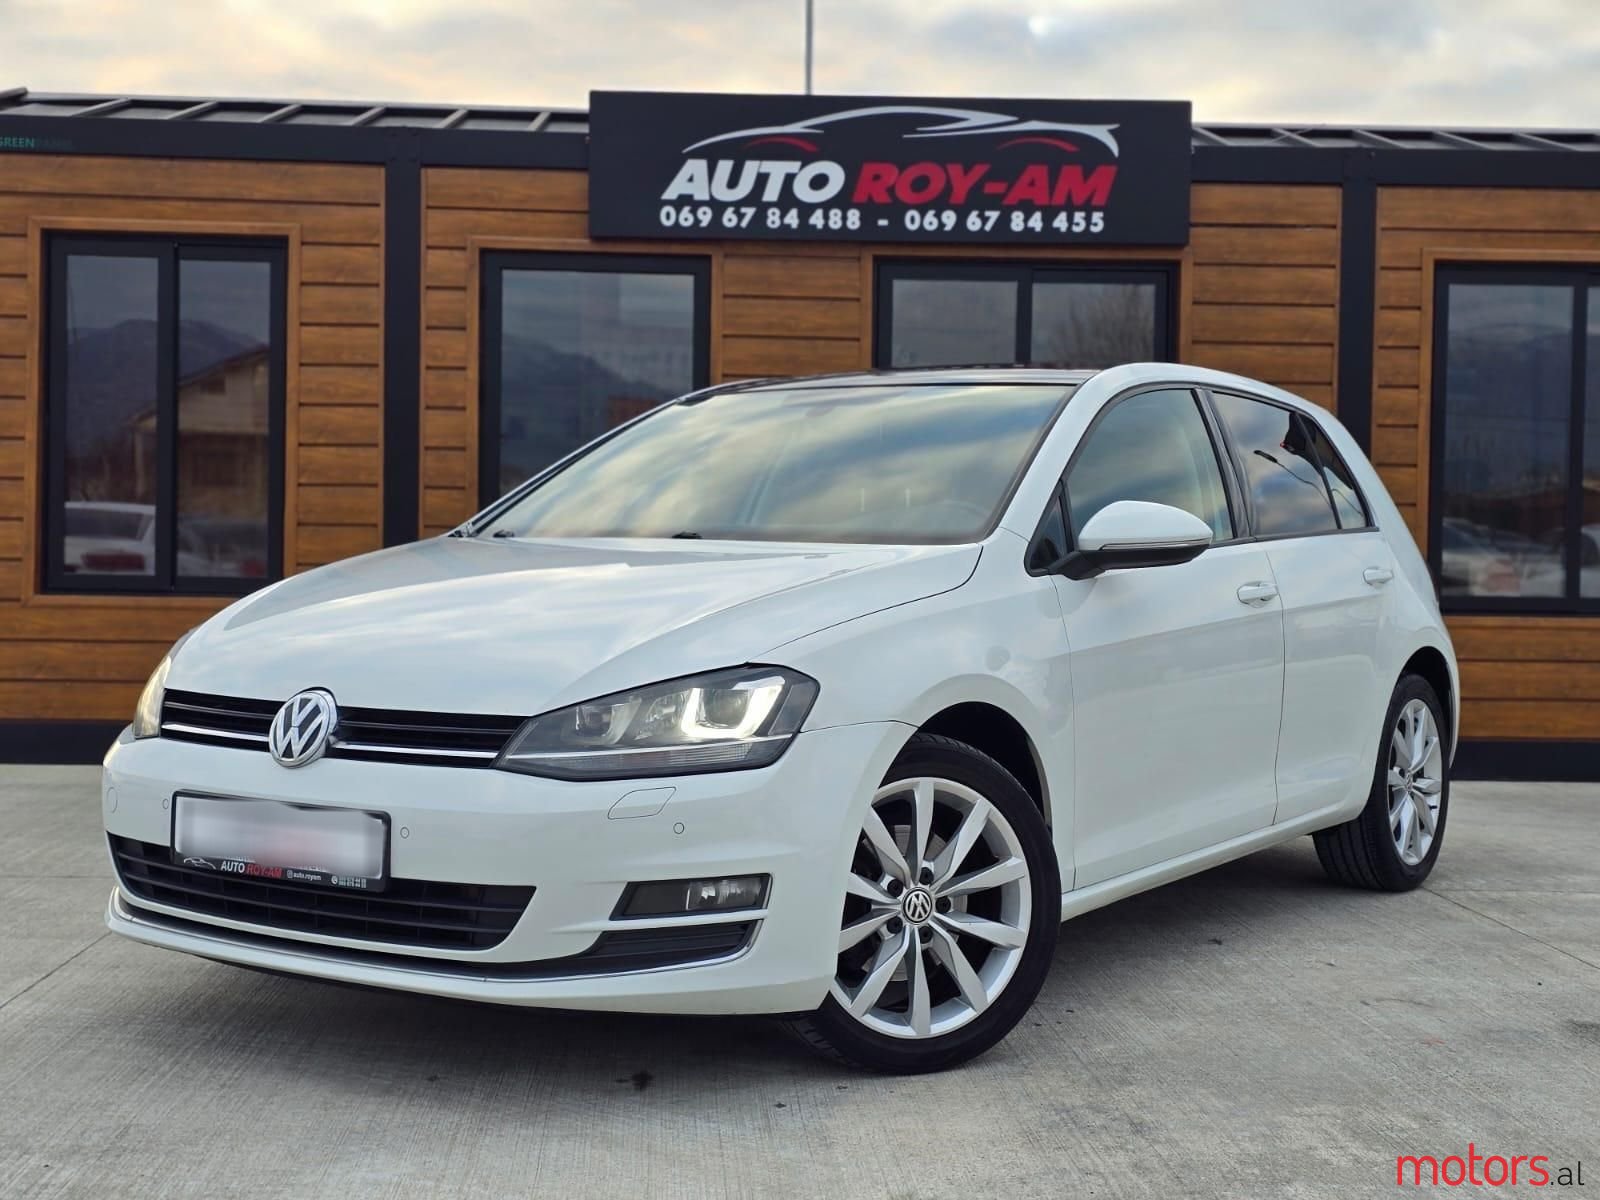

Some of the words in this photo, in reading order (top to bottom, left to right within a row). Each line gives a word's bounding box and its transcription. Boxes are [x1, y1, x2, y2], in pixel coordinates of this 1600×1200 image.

[660, 158, 846, 204] AUTO
[852, 161, 1118, 207] ROY-AM
[659, 205, 713, 228] 069
[721, 206, 757, 229] 67
[765, 206, 800, 230] 84
[808, 207, 861, 231] 488
[903, 209, 958, 232] 069
[965, 209, 1001, 233] 67
[1009, 210, 1044, 233] 84
[1051, 210, 1105, 234] 455
[220, 860, 245, 874] AUTO
